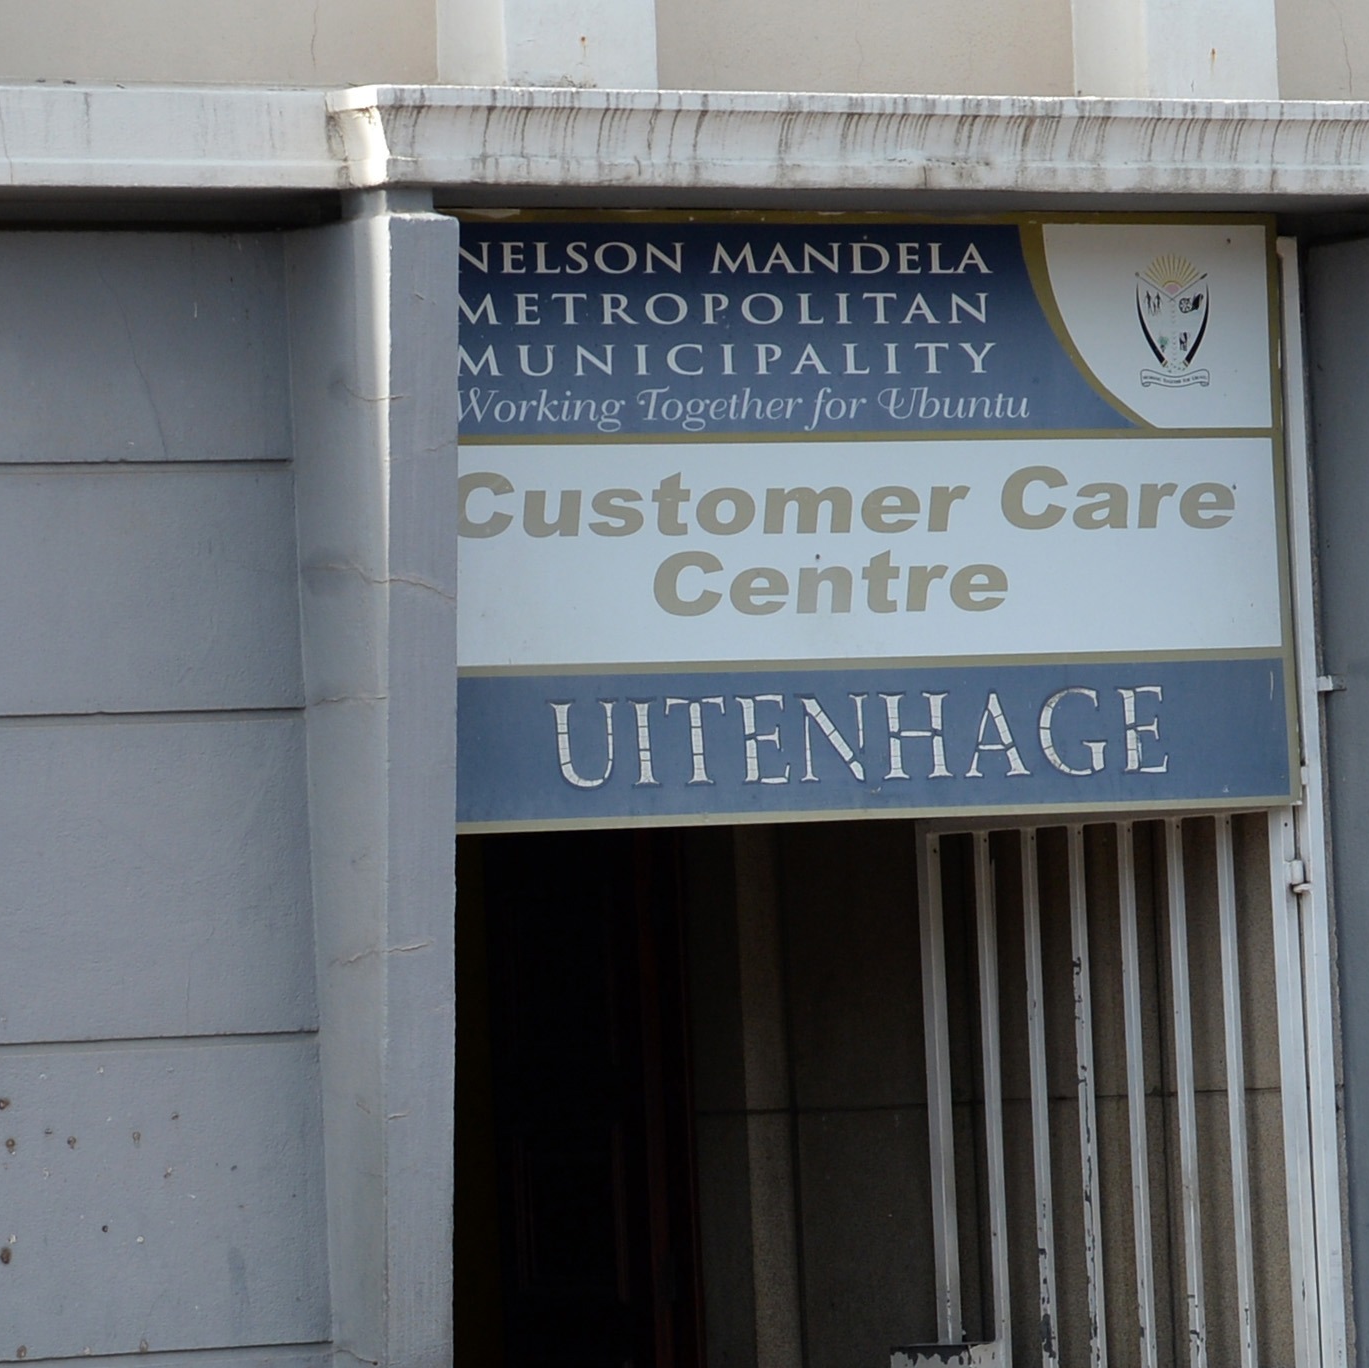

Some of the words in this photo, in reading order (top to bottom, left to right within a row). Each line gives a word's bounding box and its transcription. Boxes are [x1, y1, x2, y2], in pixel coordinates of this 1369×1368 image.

[458, 241, 685, 274] NELSON
[710, 242, 994, 275] MANDELA
[458, 292, 989, 325] METROPOLITAN
[458, 342, 997, 376] MUNICIPALITY
[458, 387, 625, 432] Working
[636, 386, 802, 431] Together
[804, 387, 867, 432] for
[877, 386, 1030, 419] Ubuntu
[457, 471, 970, 538] Customer
[1001, 465, 1236, 531] Care
[654, 550, 1008, 616] Centre
[549, 686, 1169, 789] UITENHAGE
